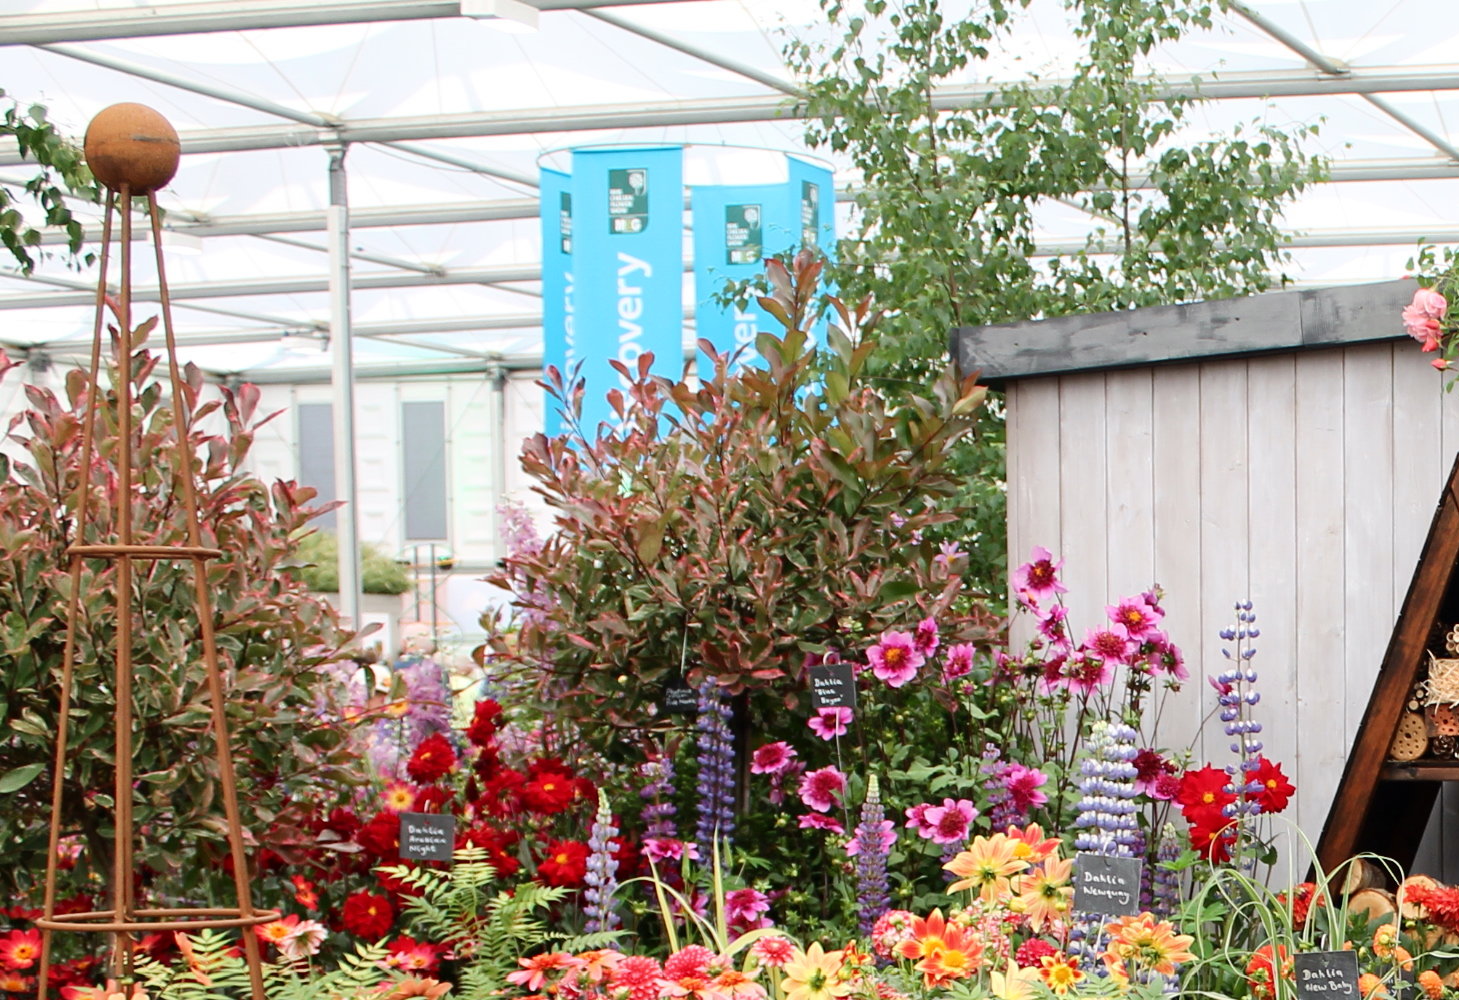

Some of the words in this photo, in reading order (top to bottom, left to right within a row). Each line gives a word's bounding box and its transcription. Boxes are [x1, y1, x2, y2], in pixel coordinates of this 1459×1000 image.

[814, 678, 843, 687] Dahlia
[408, 824, 444, 836] Dahlia
[409, 844, 436, 857] Night
[1083, 871, 1126, 885] Dahlia
[1082, 886, 1130, 905] Newquay
[1302, 968, 1344, 981] Dahlia
[1305, 983, 1327, 992] New
[1328, 980, 1353, 995] Baby
